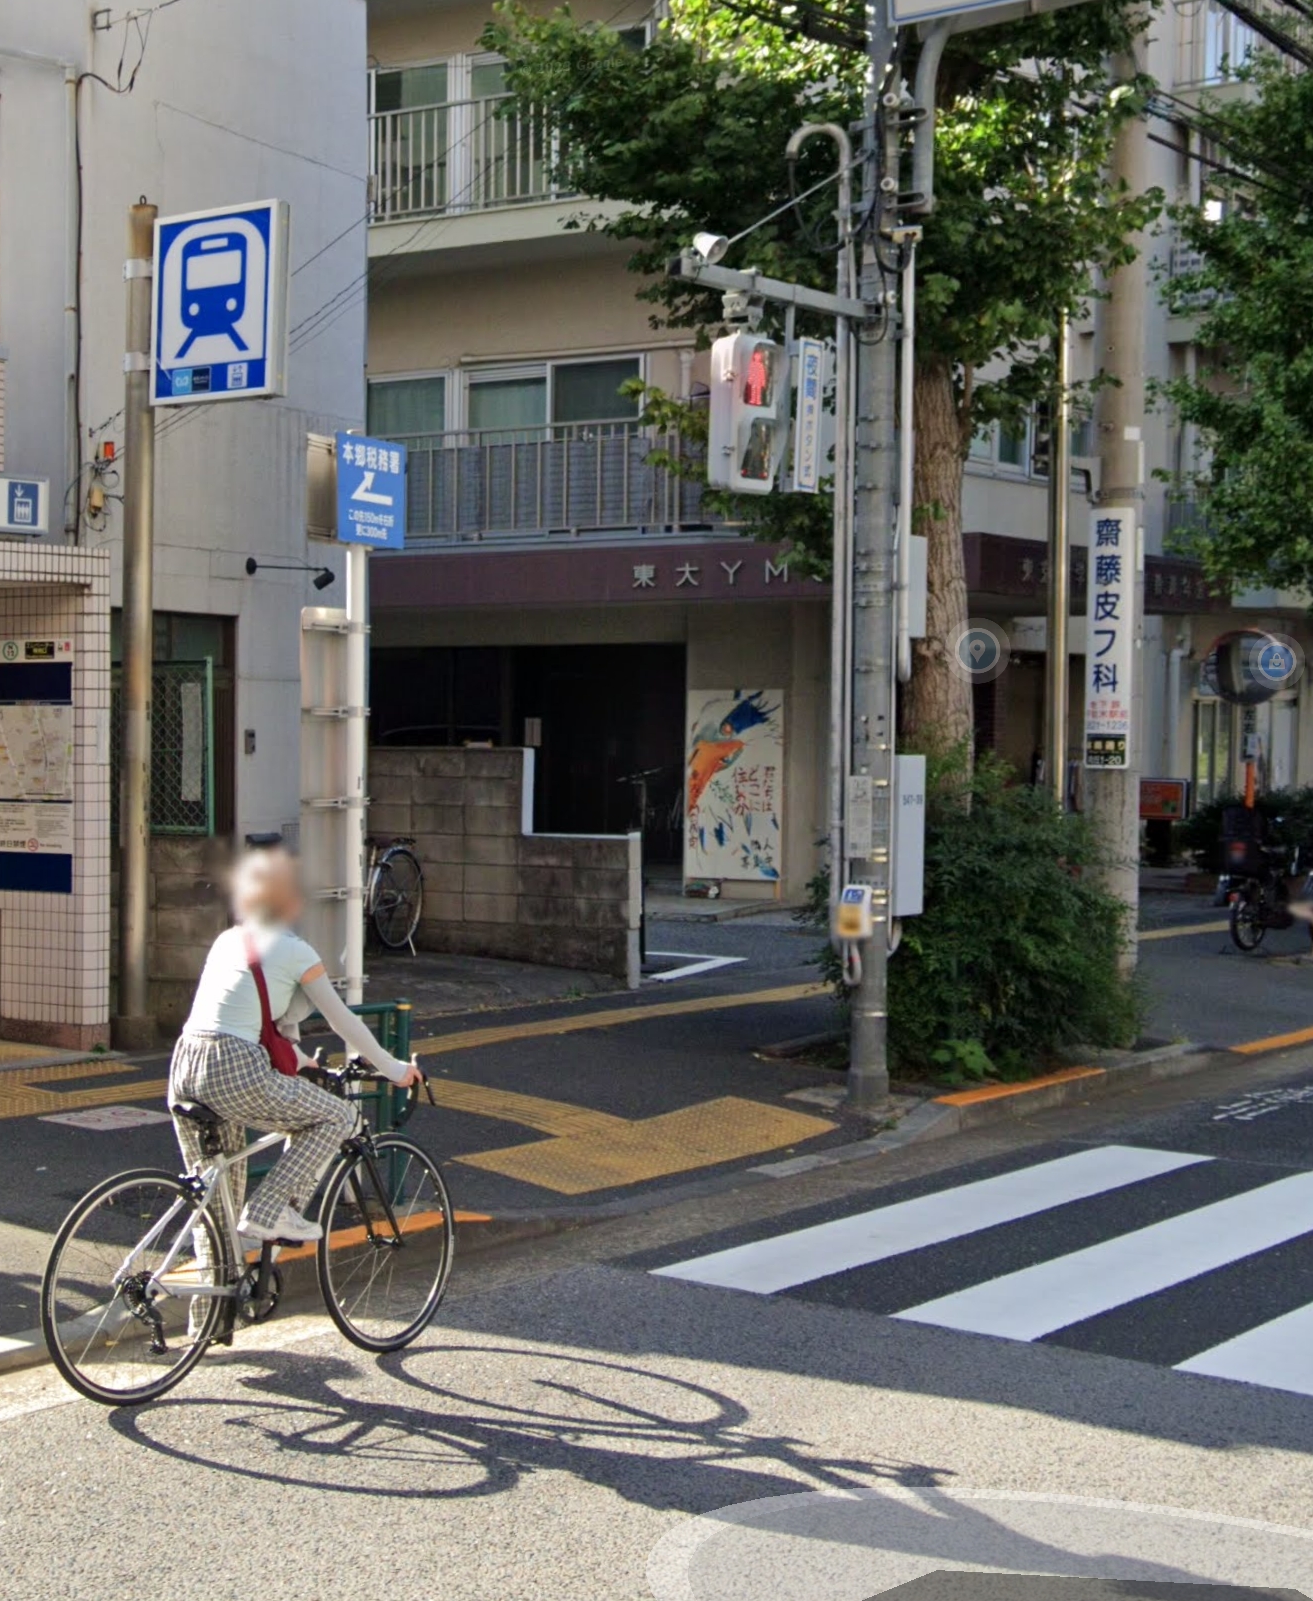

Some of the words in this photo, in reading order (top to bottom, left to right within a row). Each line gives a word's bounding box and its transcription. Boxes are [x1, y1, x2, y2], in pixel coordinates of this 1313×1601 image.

[342, 441, 400, 475] 本郷税務署
[632, 559, 822, 588] 東大YM
[1092, 518, 1123, 693] 齋藤皮フ科
